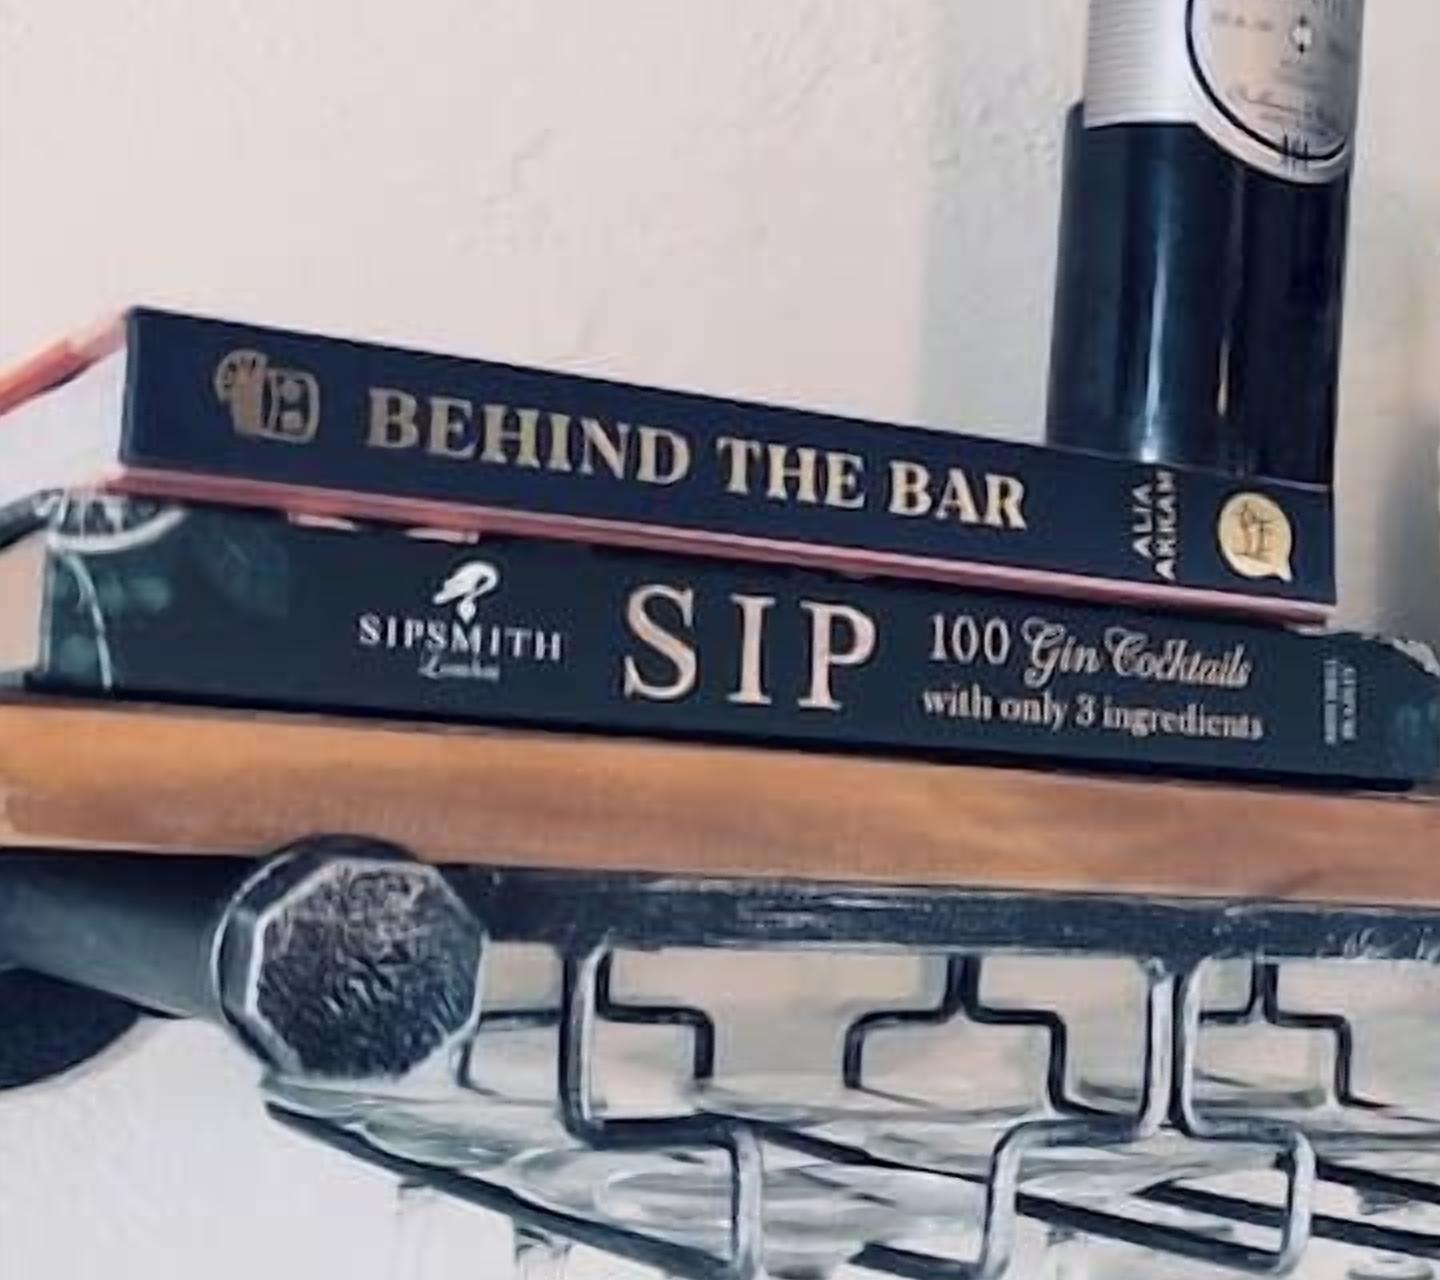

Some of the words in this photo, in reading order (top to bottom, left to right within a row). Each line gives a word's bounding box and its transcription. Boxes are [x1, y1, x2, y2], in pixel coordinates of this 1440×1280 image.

[368, 388, 690, 485] BEHIND
[716, 436, 866, 508] THE
[889, 461, 1026, 529] BAR
[358, 613, 563, 661] SIPSMITH
[930, 614, 1011, 664] 100
[1021, 616, 1101, 689] Gin
[1104, 625, 1253, 689] Cocktails
[923, 683, 993, 720] with
[1000, 692, 1068, 732] only
[1075, 693, 1097, 729] 3
[1103, 697, 1265, 740] ingredients
